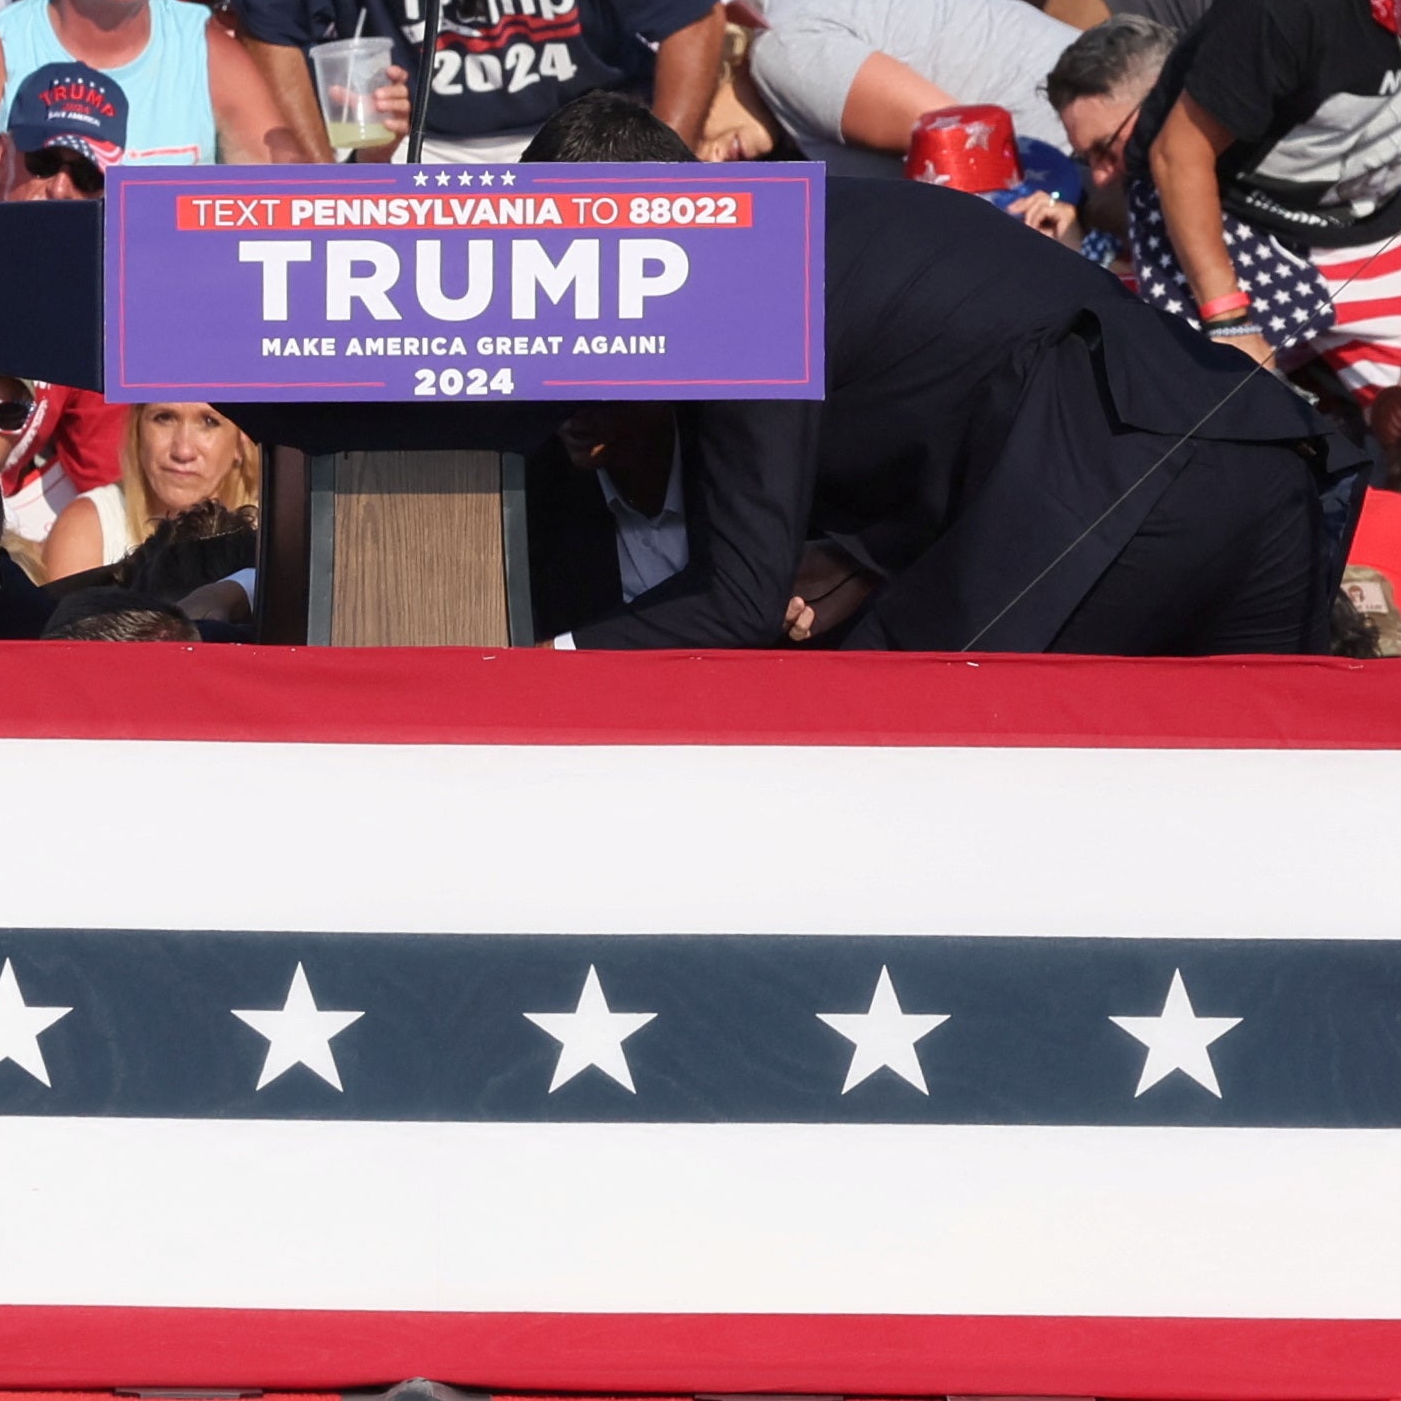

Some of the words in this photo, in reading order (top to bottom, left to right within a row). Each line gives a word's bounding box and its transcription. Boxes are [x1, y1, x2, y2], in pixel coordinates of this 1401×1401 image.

[433, 43, 577, 95] 2024
[38, 83, 116, 118] TRUMP
[192, 199, 278, 227] TEXT
[291, 196, 559, 226] PENNSYLVANIA
[573, 198, 619, 224] TO
[628, 197, 738, 225] 88022
[239, 239, 690, 322] TRUMP
[261, 337, 337, 358] MAKE
[345, 336, 468, 358] AMERICA
[476, 336, 564, 357] GREAT
[572, 335, 667, 356] AGAIN!
[414, 367, 515, 397] 2024
